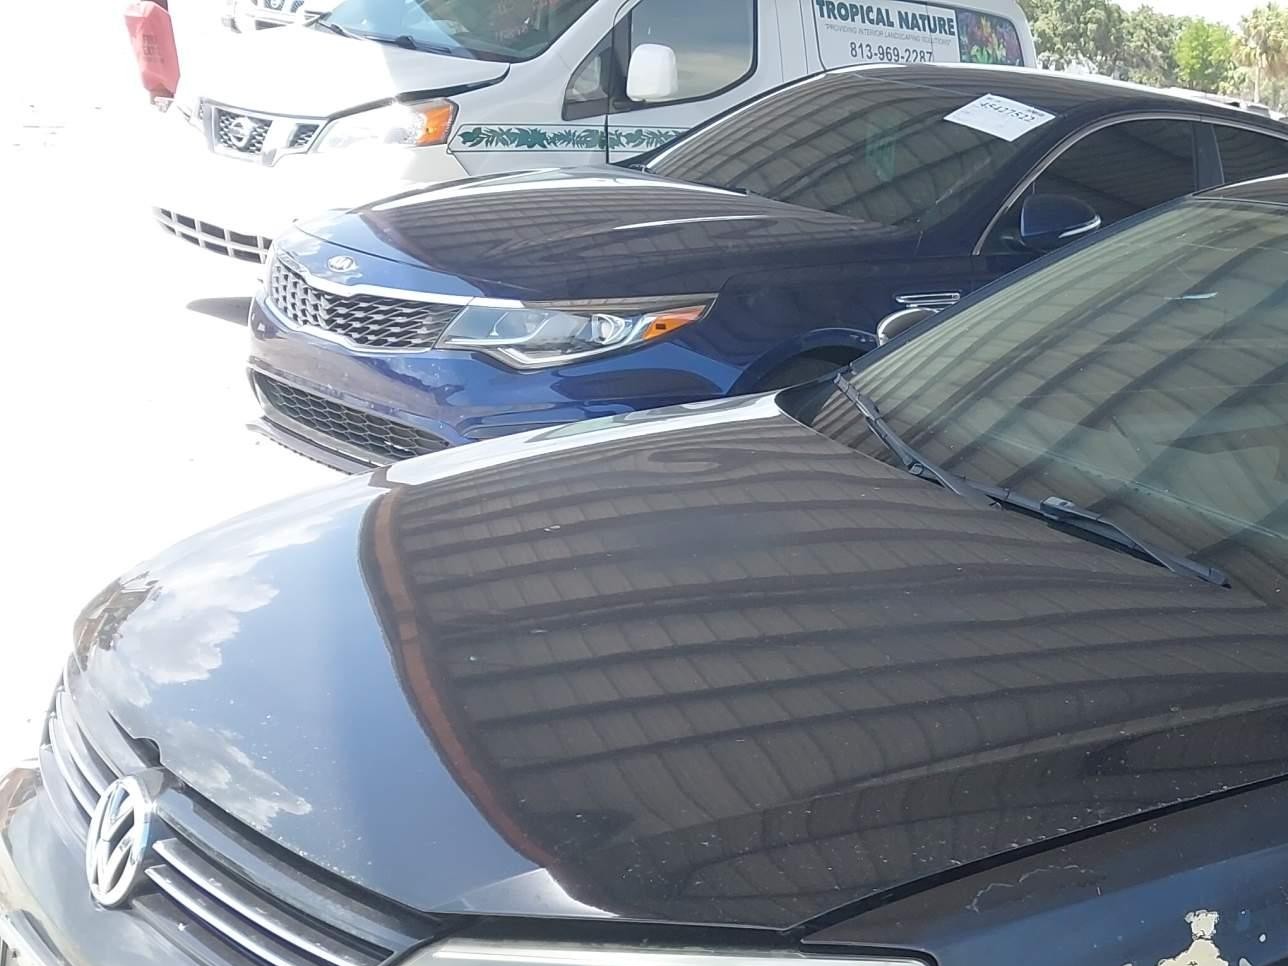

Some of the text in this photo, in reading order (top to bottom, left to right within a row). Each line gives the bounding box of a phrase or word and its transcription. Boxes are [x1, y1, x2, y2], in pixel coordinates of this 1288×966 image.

[815, 0, 956, 36] TROPICAL NATURE
[849, 40, 933, 63] 813-969-2287
